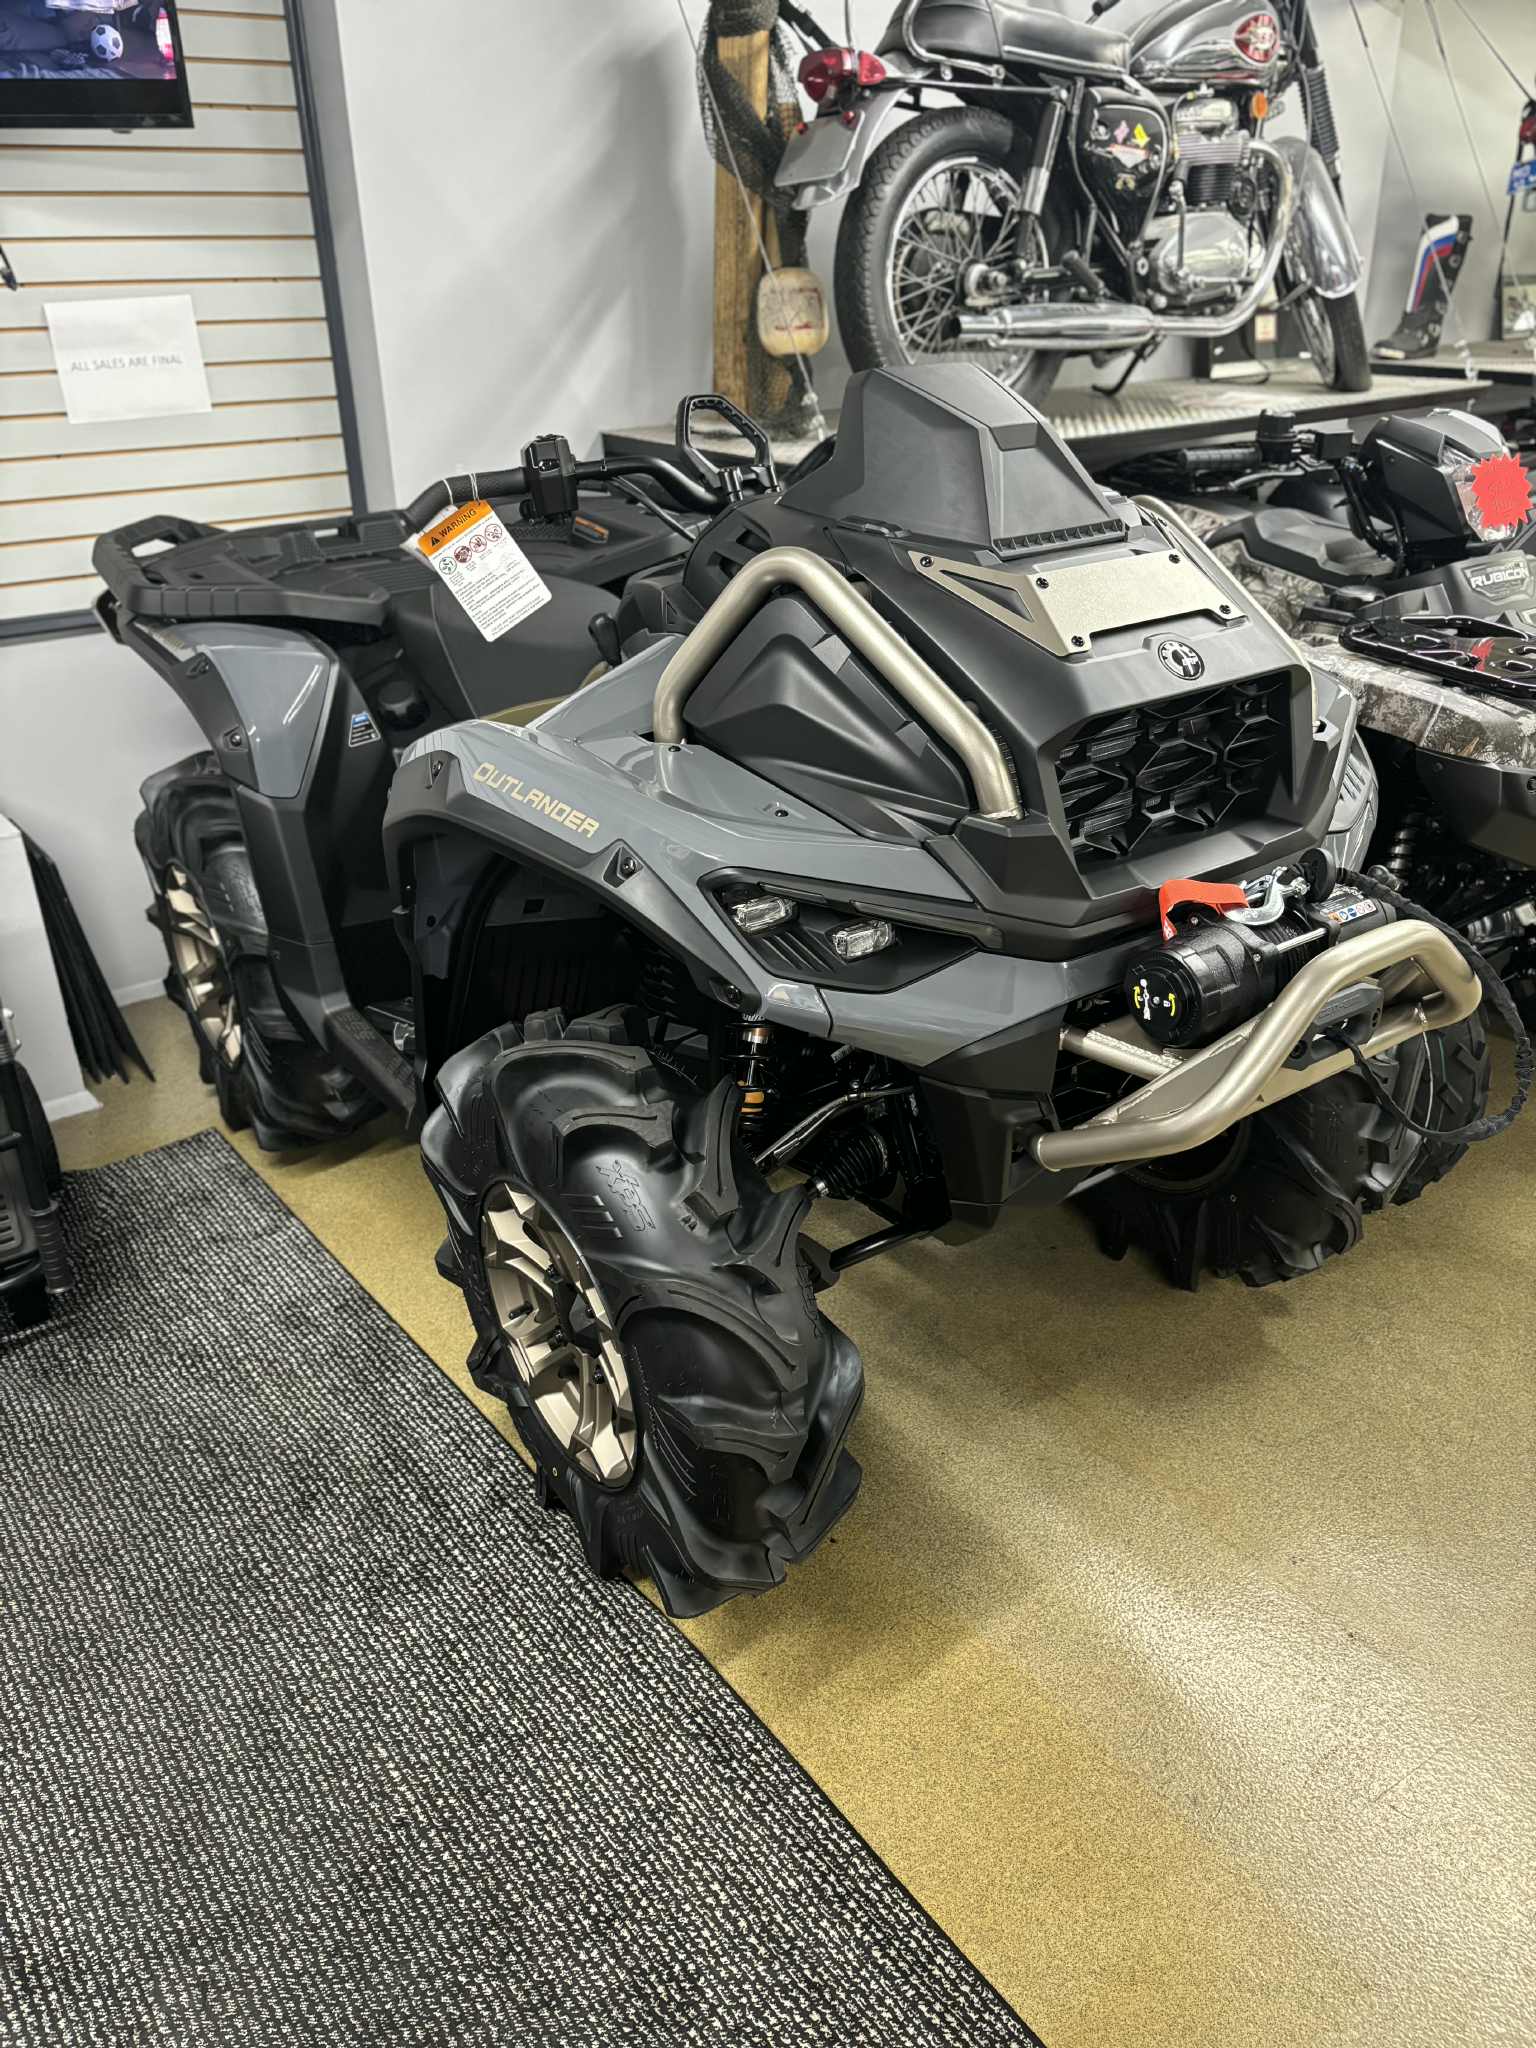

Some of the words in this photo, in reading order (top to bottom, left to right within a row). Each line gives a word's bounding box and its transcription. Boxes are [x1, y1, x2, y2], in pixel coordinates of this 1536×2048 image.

[71, 361, 90, 372] ALL
[94, 358, 125, 370] SALES
[129, 356, 148, 367] ARE
[152, 354, 184, 366] FINAL
[439, 508, 477, 538] WARNING
[1470, 567, 1530, 589] RUBICON
[473, 762, 600, 838] OUTLANDER
